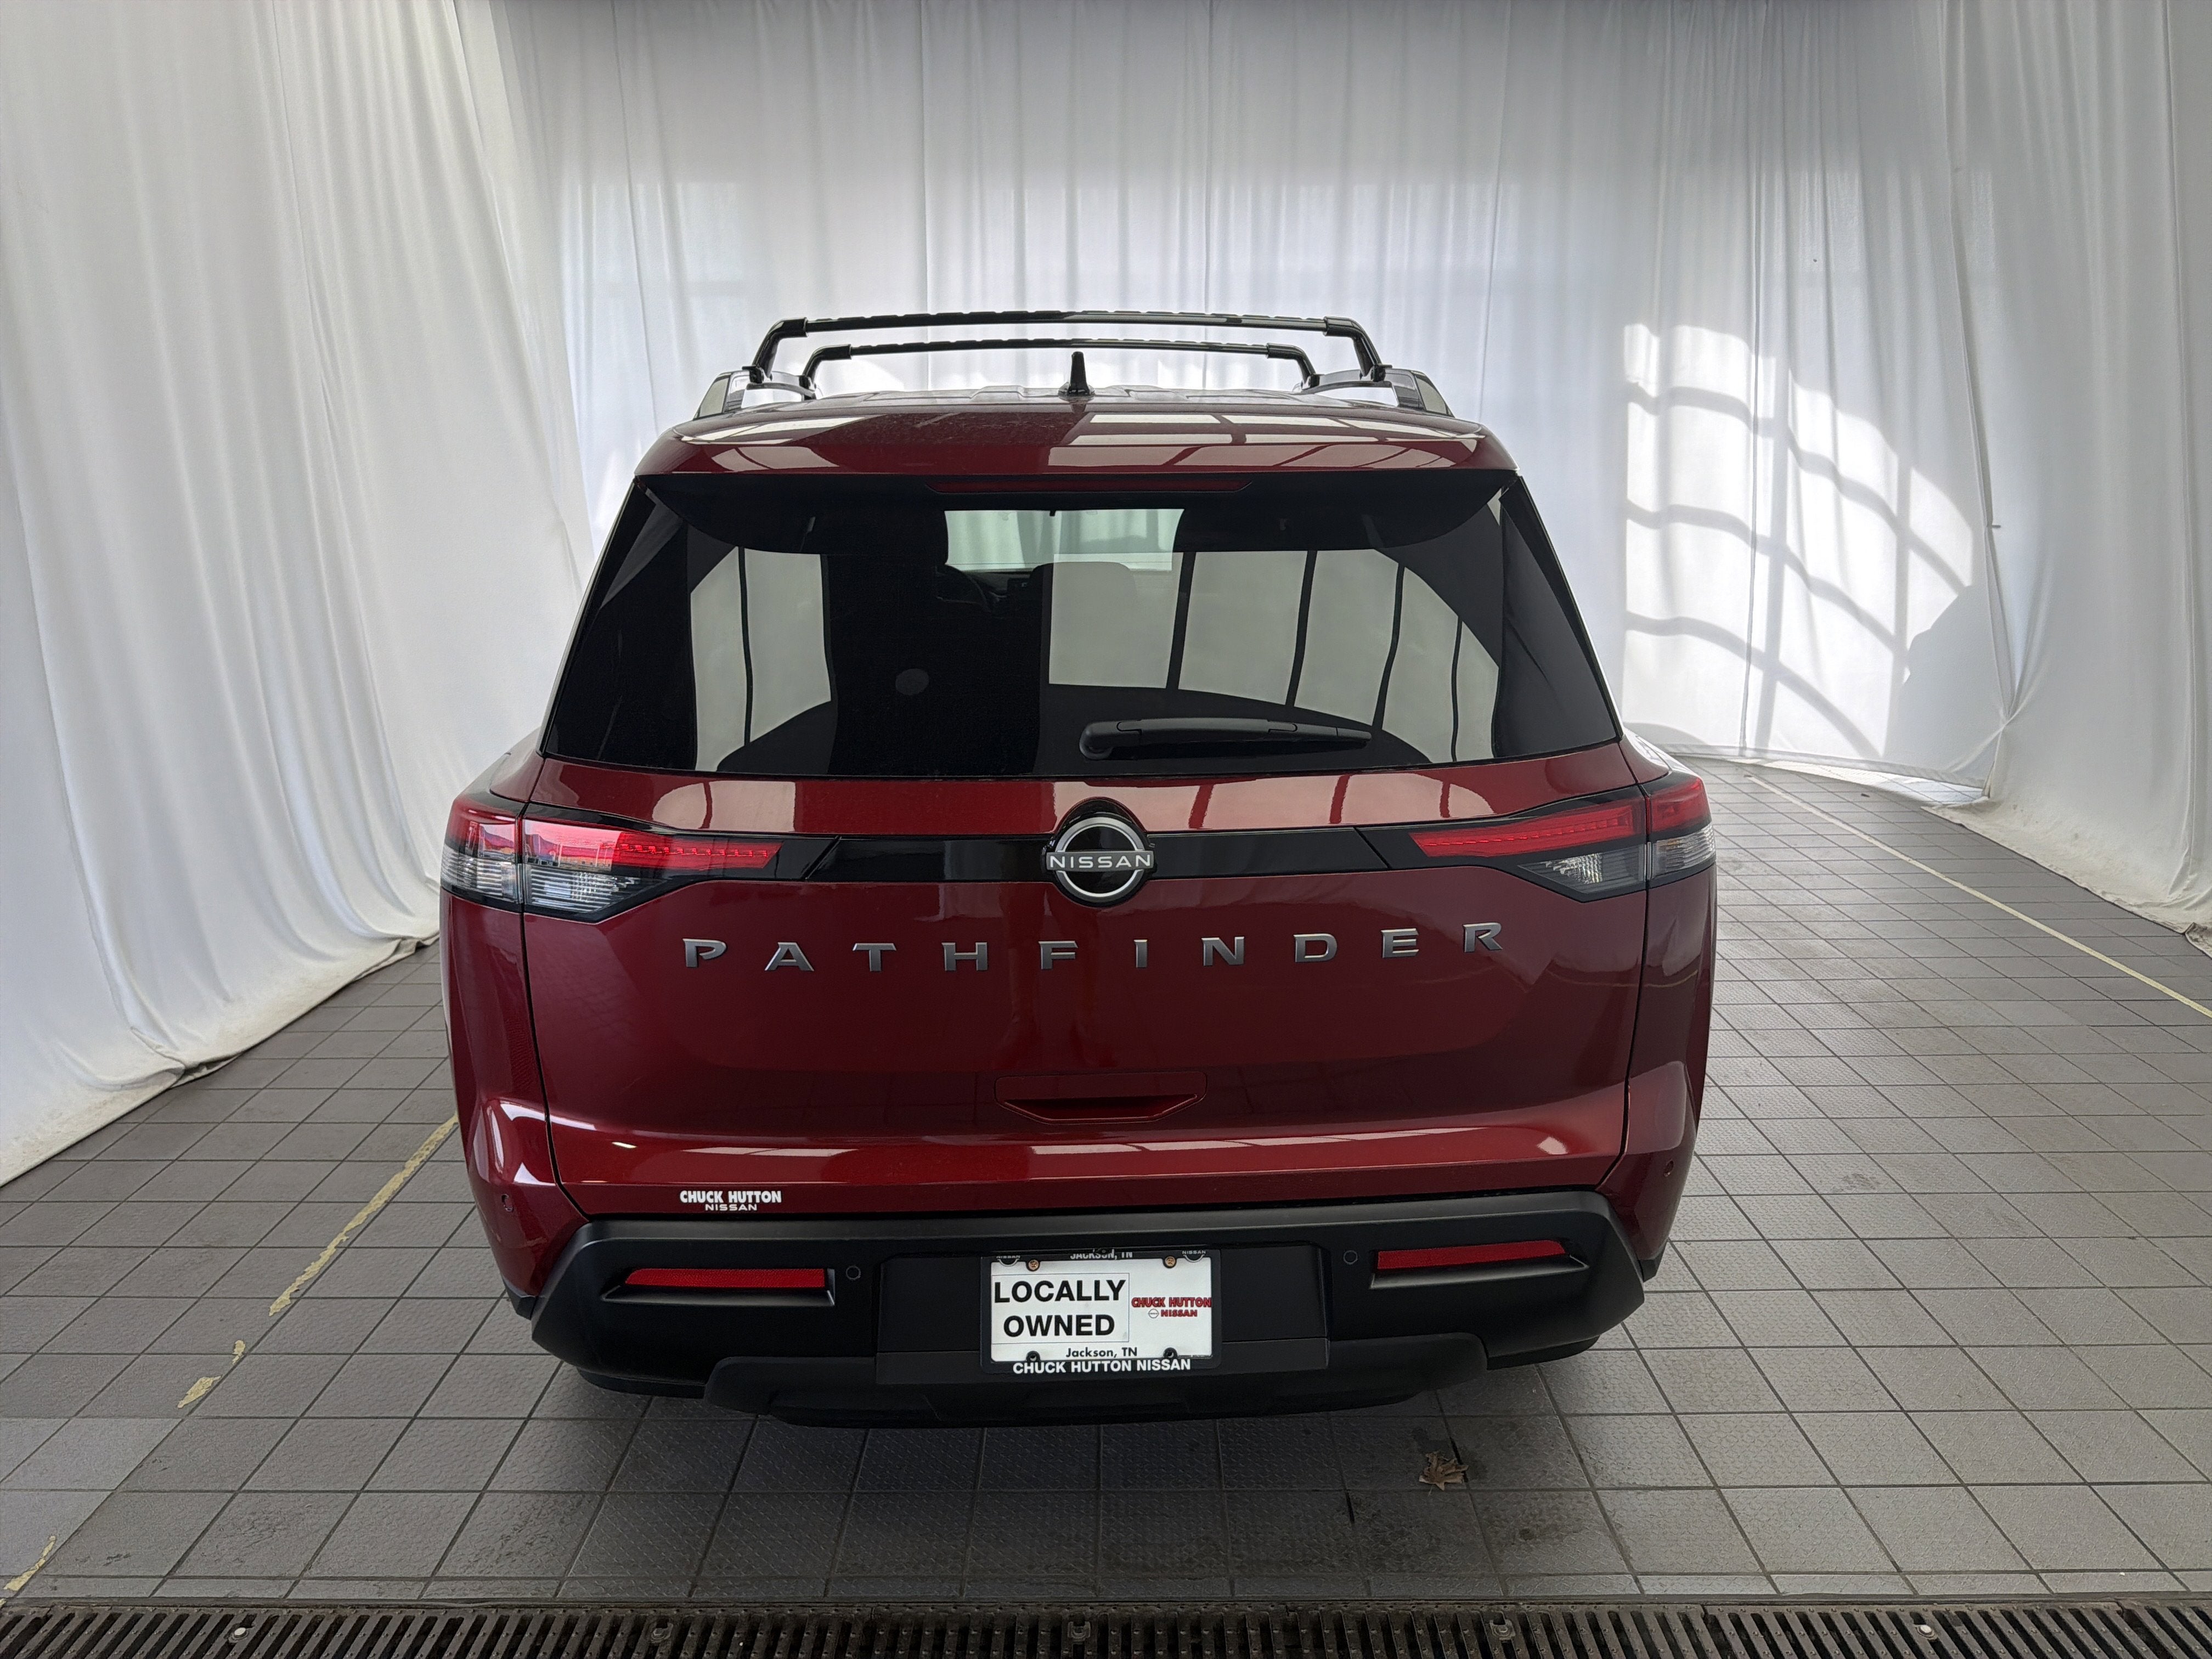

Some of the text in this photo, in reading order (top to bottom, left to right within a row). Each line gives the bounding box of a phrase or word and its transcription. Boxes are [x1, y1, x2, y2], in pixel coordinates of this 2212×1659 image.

[1049, 854, 1151, 868] NISSAN
[682, 922, 1504, 972] PATHFINDER
[680, 1190, 782, 1203] CHUCK HUTTON
[994, 1279, 1126, 1303] LOCALLY
[1131, 1297, 1212, 1308] CHUCK HUTTON
[1003, 1314, 1115, 1338] OWNED
[1065, 1347, 1138, 1358] Jackson, TN
[1012, 1358, 1191, 1374] CHUCK HUTTON NISSAN
